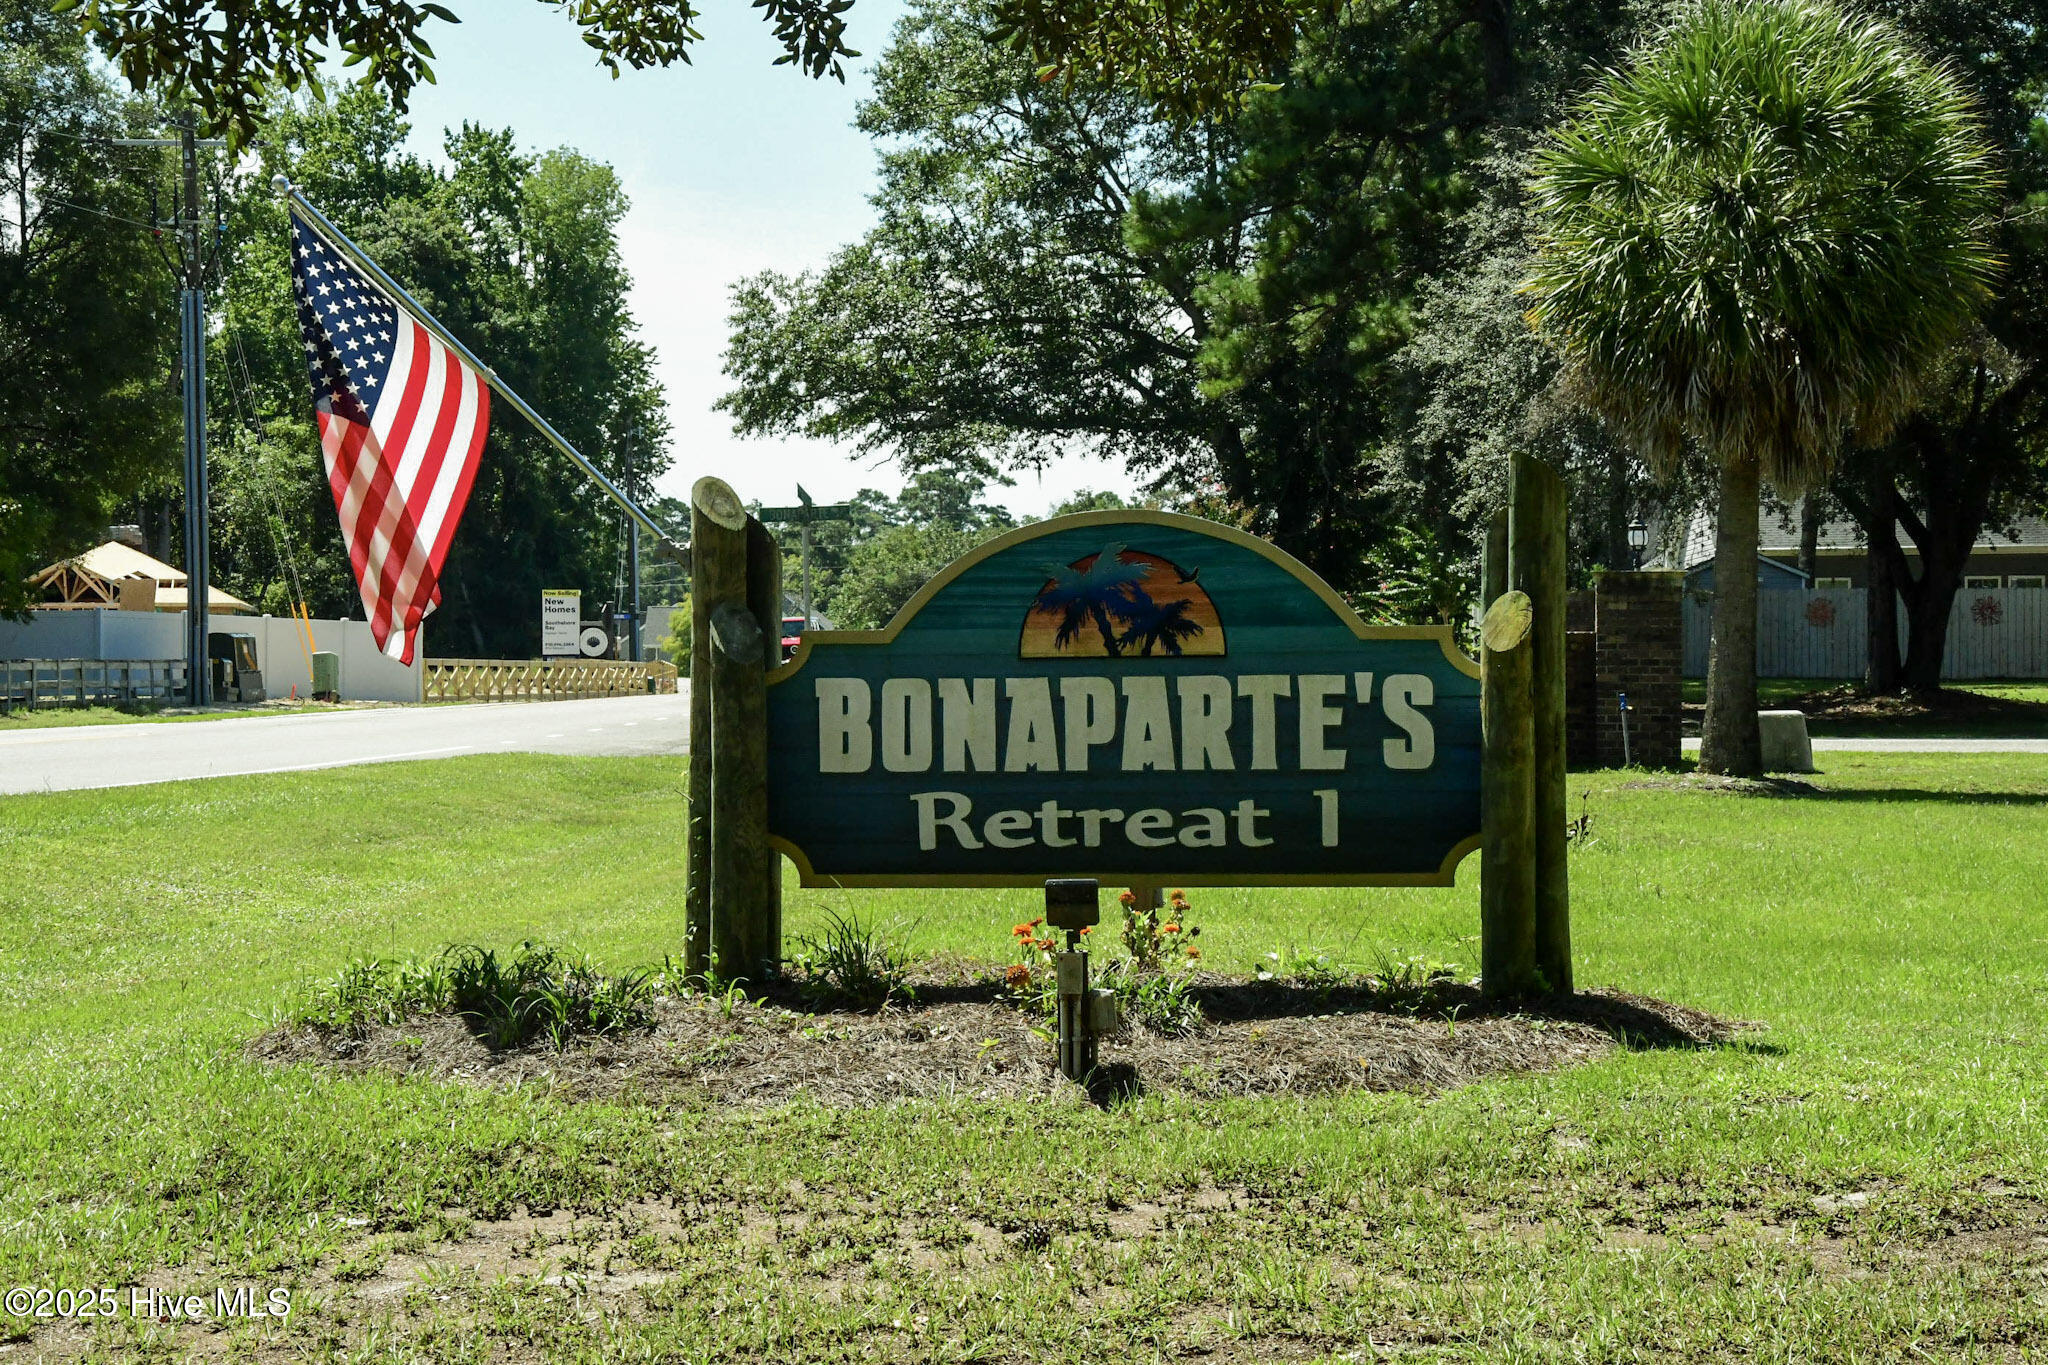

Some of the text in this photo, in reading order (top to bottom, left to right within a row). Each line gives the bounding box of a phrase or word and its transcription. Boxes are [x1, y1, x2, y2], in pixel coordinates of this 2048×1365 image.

[815, 672, 1435, 774] BONAPARTE'S
[910, 789, 1339, 851] Retreat 1
